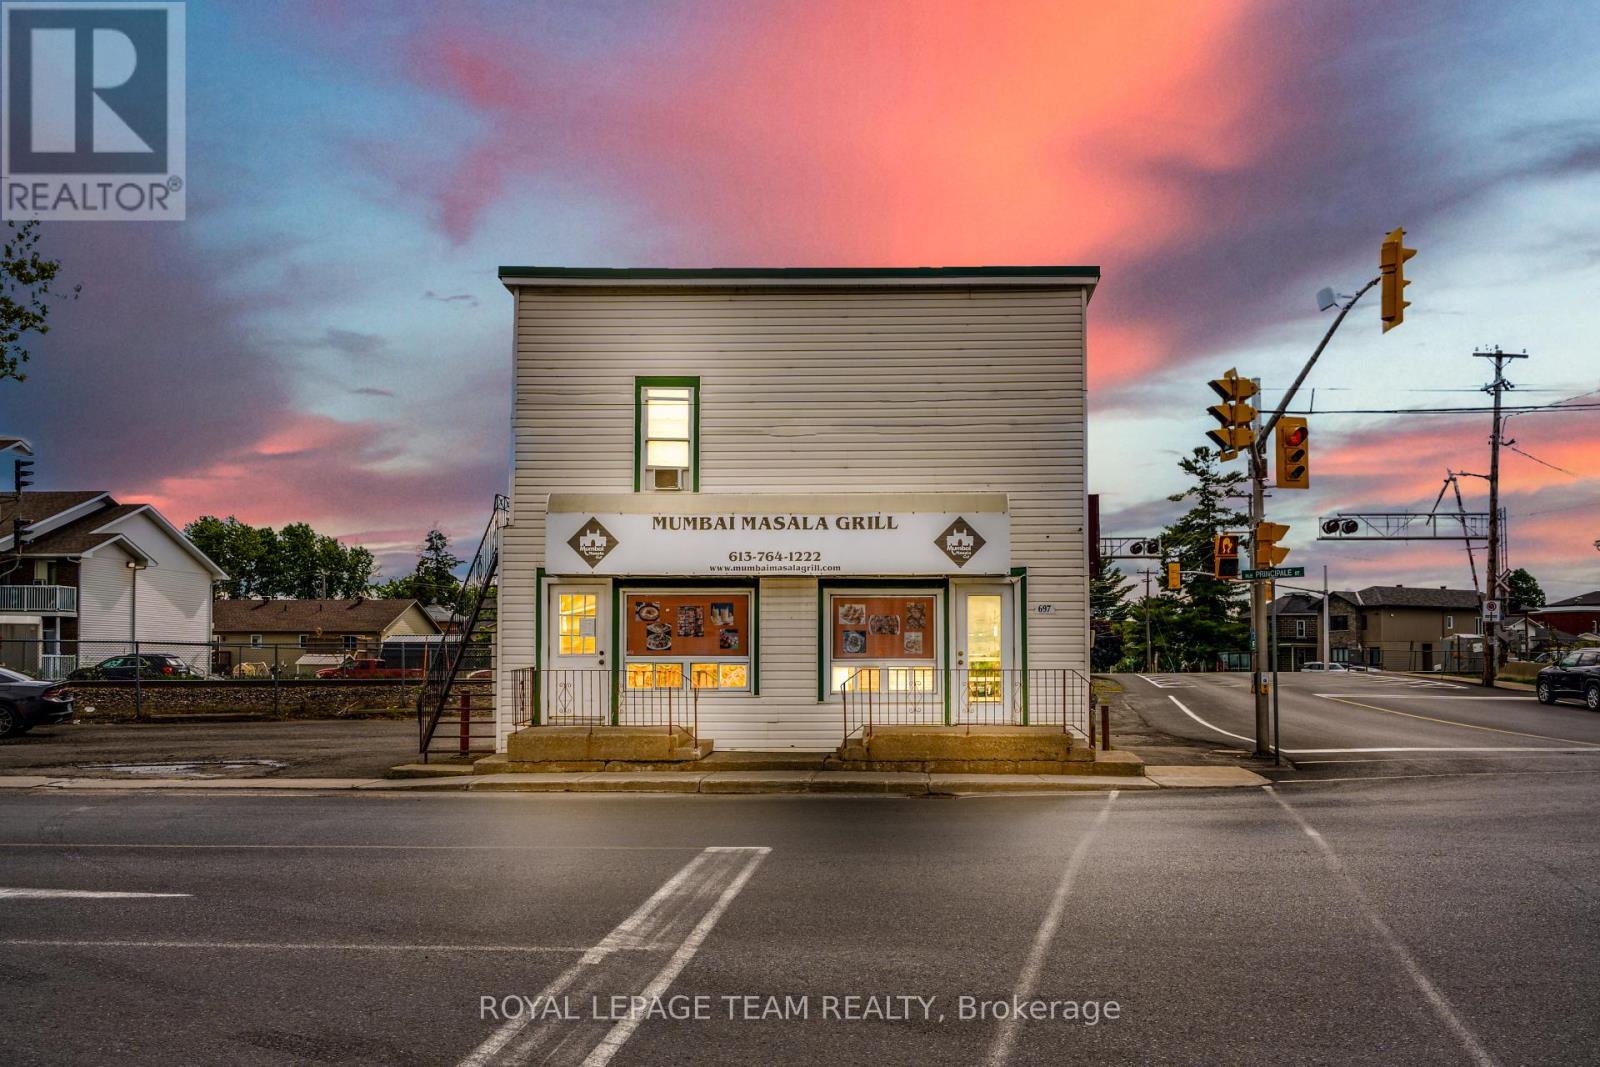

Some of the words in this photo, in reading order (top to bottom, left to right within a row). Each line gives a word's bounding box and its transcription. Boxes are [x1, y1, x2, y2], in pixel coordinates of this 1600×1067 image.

[652, 516, 735, 530] MUMBAI
[741, 516, 829, 530] MASALA
[835, 516, 898, 530] GRILL
[728, 551, 821, 562] 613-764-1222
[709, 564, 841, 573] www.mumbaimasalagrill.com
[1255, 568, 1293, 578] PRINCIPALE
[1038, 604, 1051, 613] 697
